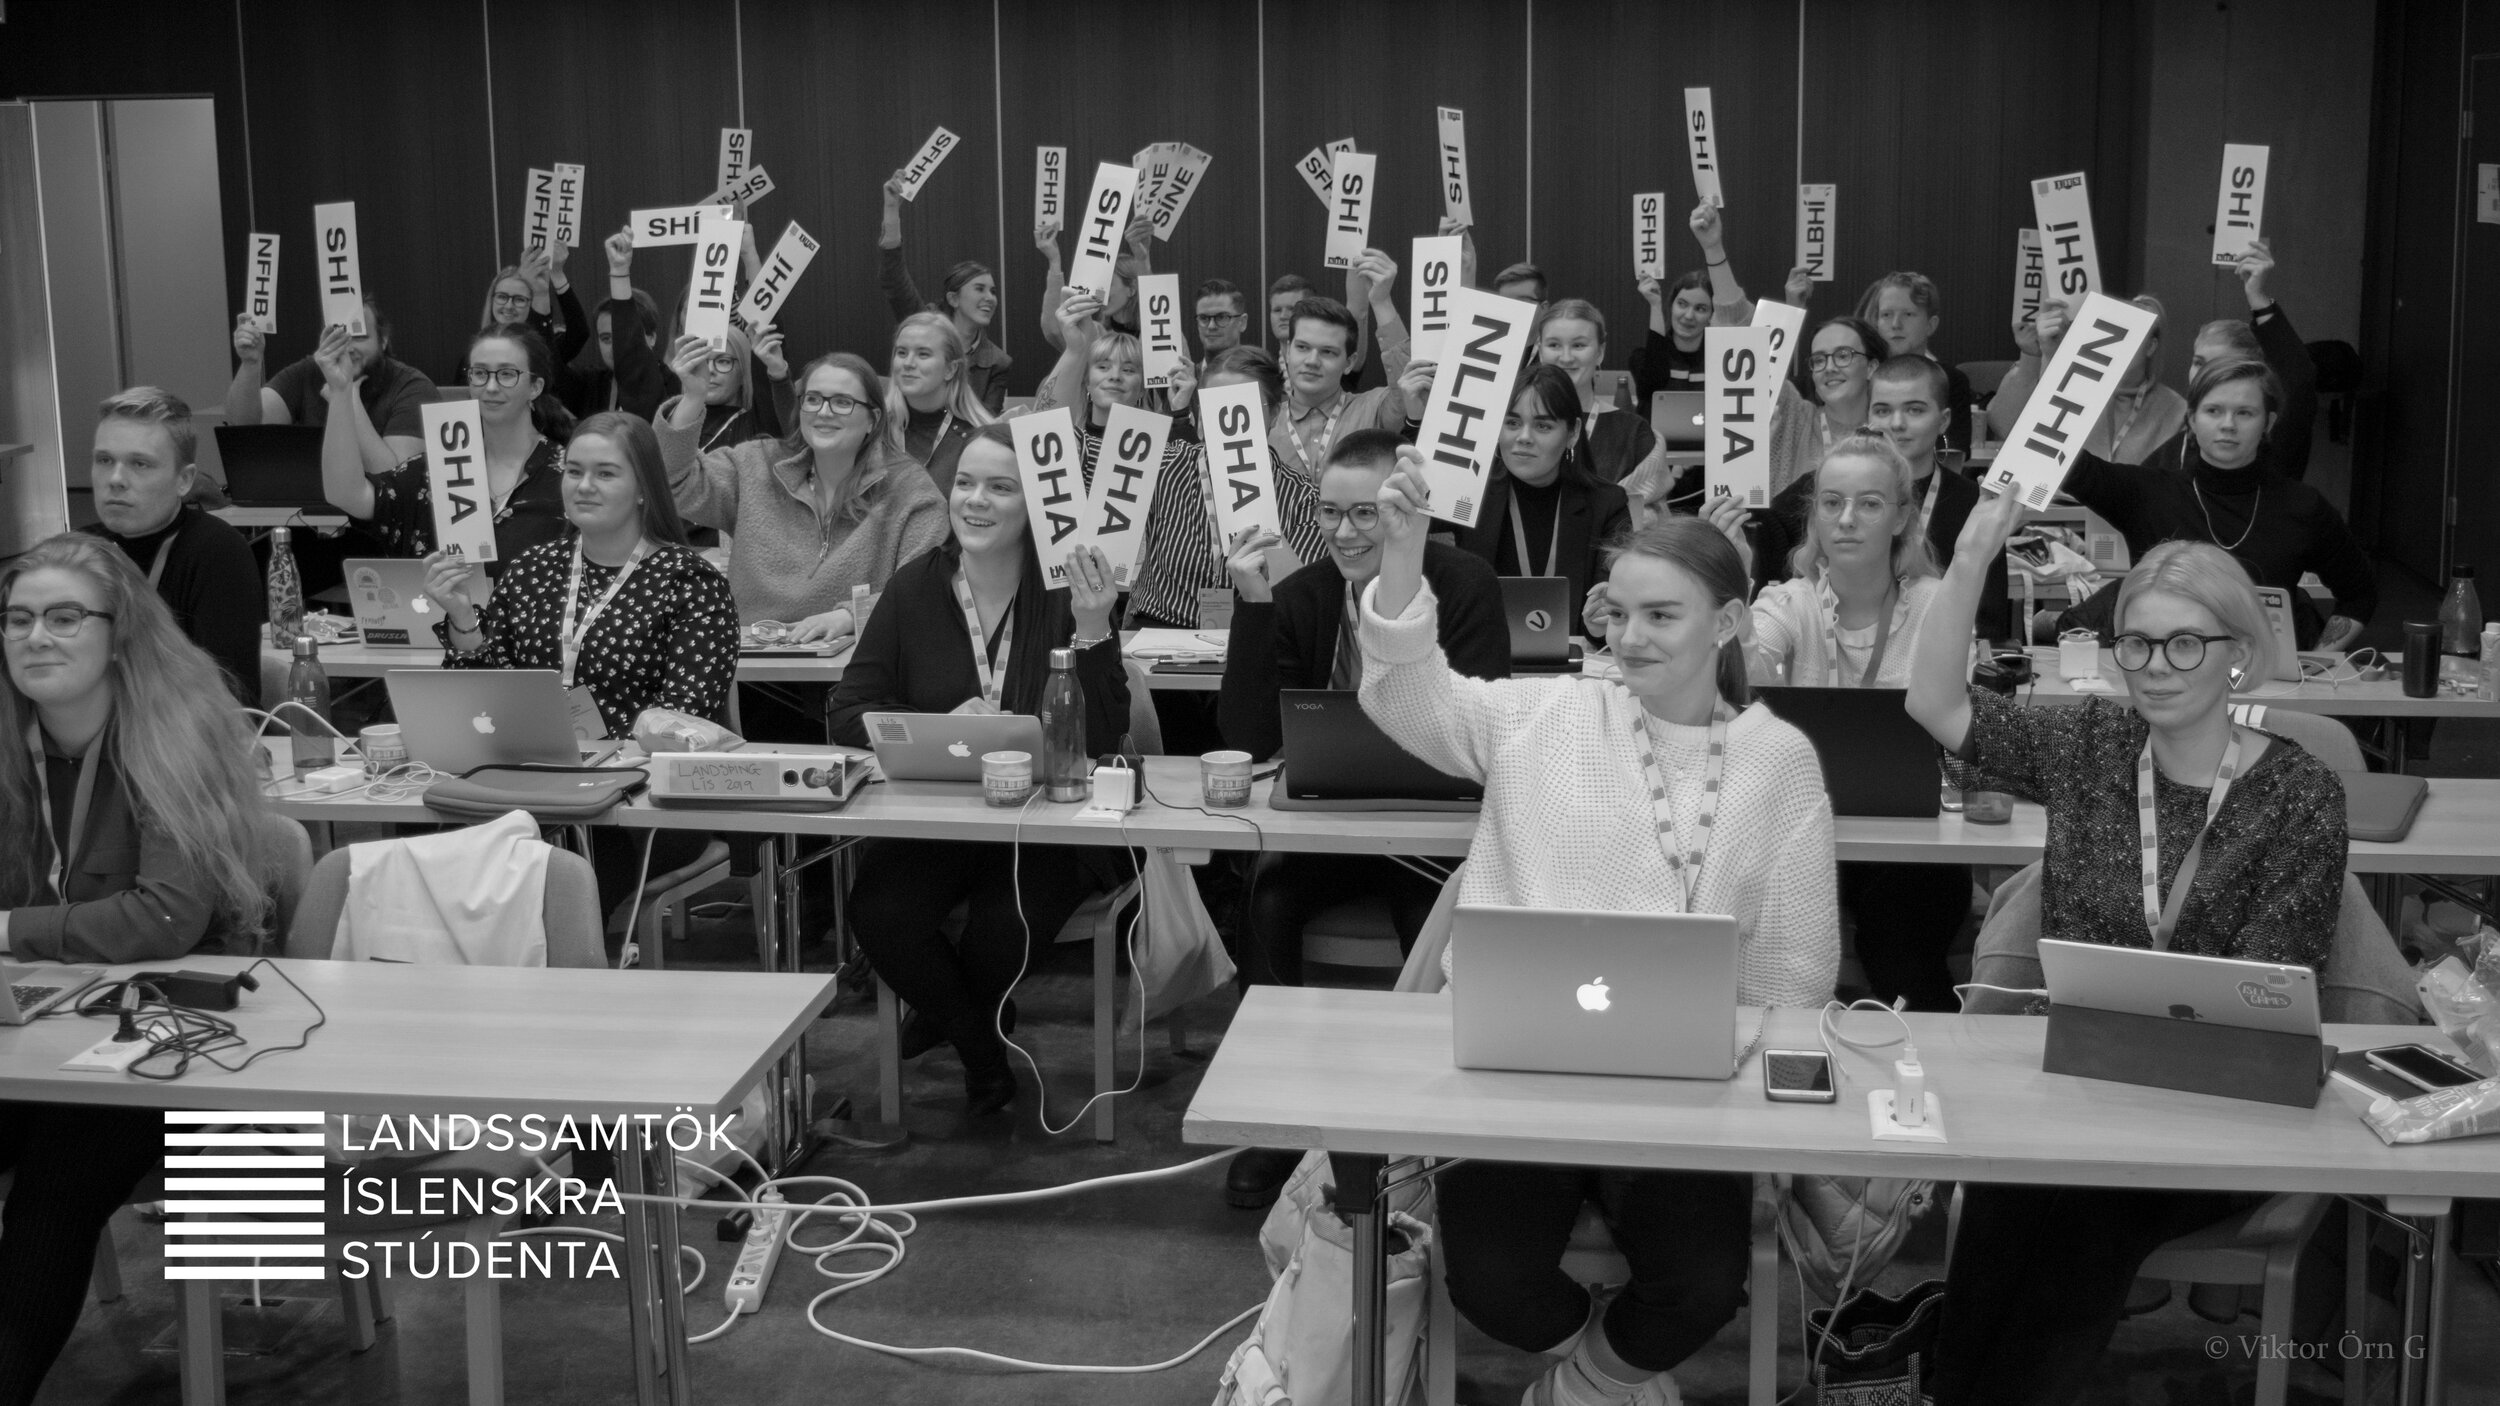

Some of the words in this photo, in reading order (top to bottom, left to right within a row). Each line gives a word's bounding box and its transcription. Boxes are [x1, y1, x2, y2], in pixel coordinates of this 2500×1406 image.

[726, 133, 745, 185] SFH
[904, 133, 952, 185] SFHR
[1305, 156, 1333, 192] SF
[1443, 142, 1463, 204] SHÍ
[1692, 110, 1713, 171] SHÍ
[557, 179, 575, 241] SFHR
[1042, 150, 1060, 218] SFHR
[1152, 166, 1195, 228] SÍNE
[1336, 173, 1364, 235] SHÍ
[2228, 166, 2255, 229] SHÍ
[648, 210, 702, 238] SHÍ
[1087, 188, 1121, 262] SHÍ
[1641, 197, 1657, 265] SFHR
[1803, 199, 1826, 277] NLBHÍ
[2046, 221, 2087, 295] SHÍ
[254, 239, 273, 317] NFHB
[327, 226, 355, 295] SHÍ
[698, 242, 729, 311] SHÍ
[753, 253, 795, 313] SHÍ
[2022, 244, 2043, 323] NLBHÍ
[1149, 294, 1178, 354] SHÍ
[1422, 261, 1450, 332] SHÍ
[1433, 314, 1511, 477] NLHÍ
[1723, 348, 1754, 464] SHA
[2024, 318, 2130, 468] NLHÍ
[440, 418, 480, 527] SHA
[1031, 431, 1078, 546] SHA
[1098, 428, 1151, 536] SHA
[1217, 404, 1261, 514] SHA
[726, 779, 754, 791] 2019
